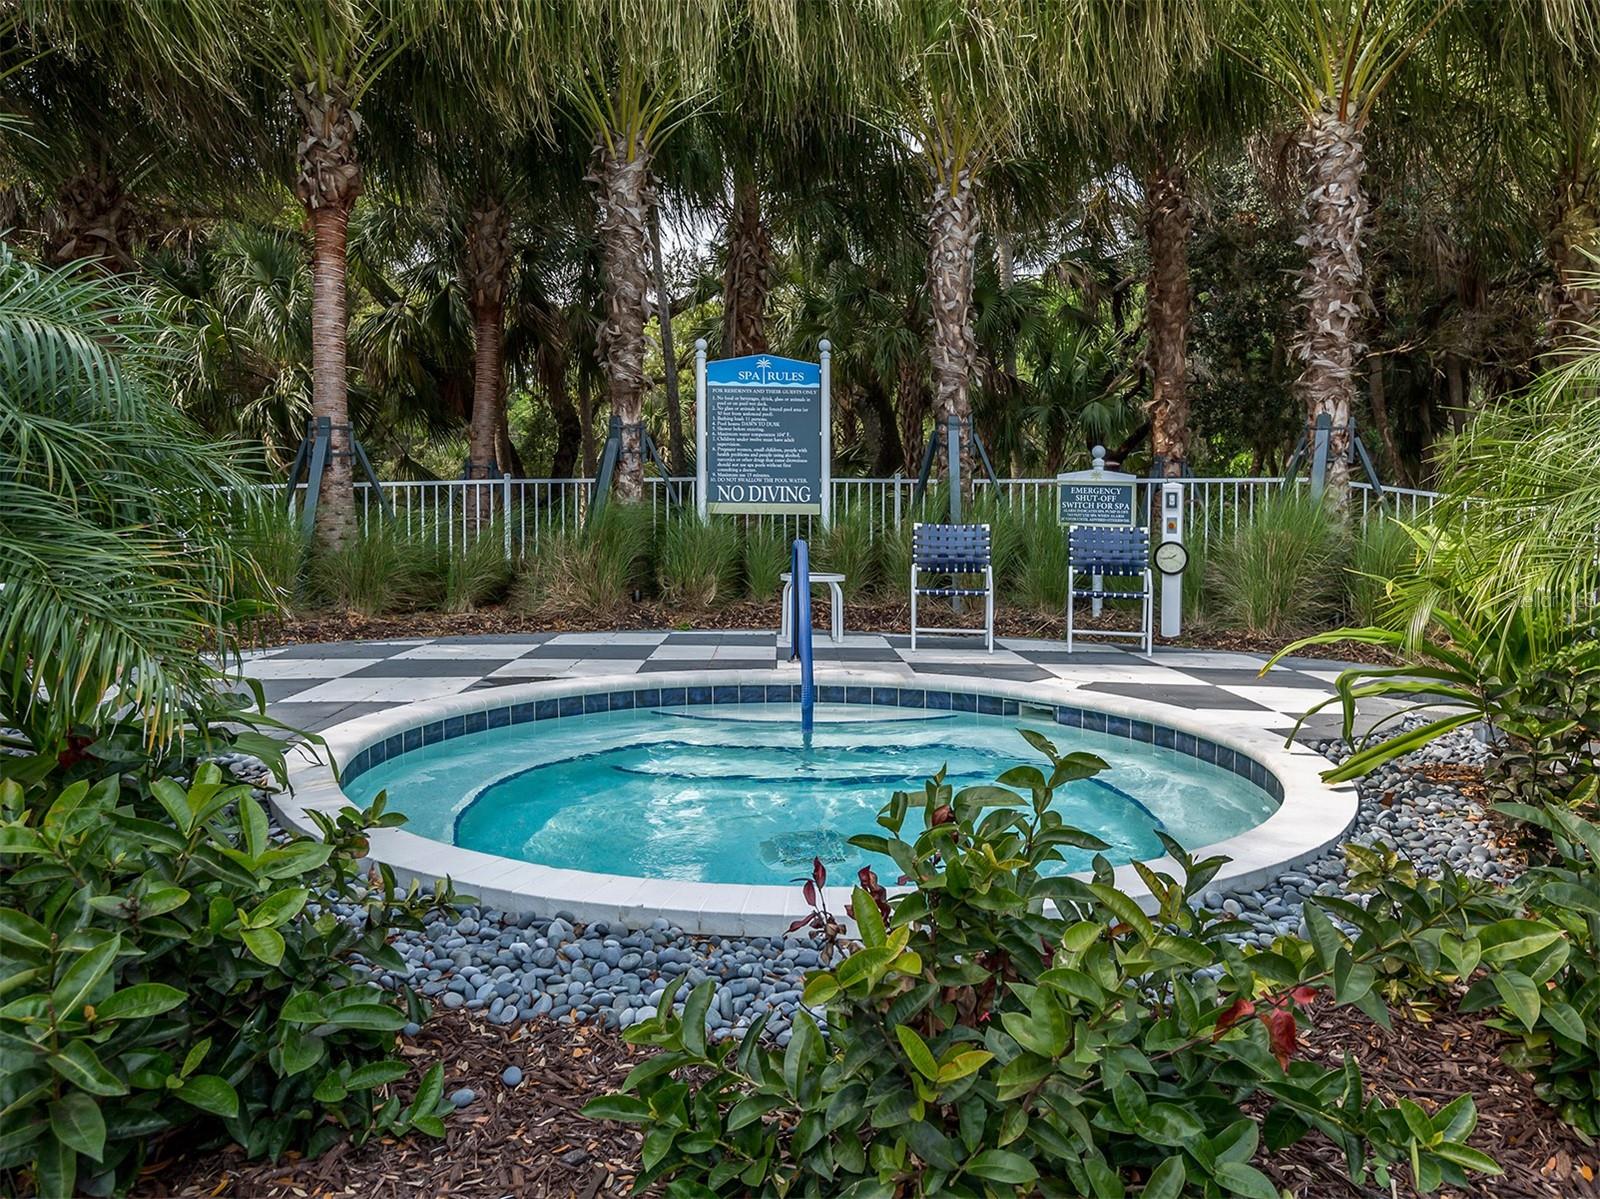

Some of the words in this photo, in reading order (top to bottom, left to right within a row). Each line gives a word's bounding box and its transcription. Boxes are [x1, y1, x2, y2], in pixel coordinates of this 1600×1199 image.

[738, 371, 760, 381] SPA
[768, 372, 804, 382] RULES
[717, 485, 744, 502] NO
[748, 485, 811, 503] DIVING
